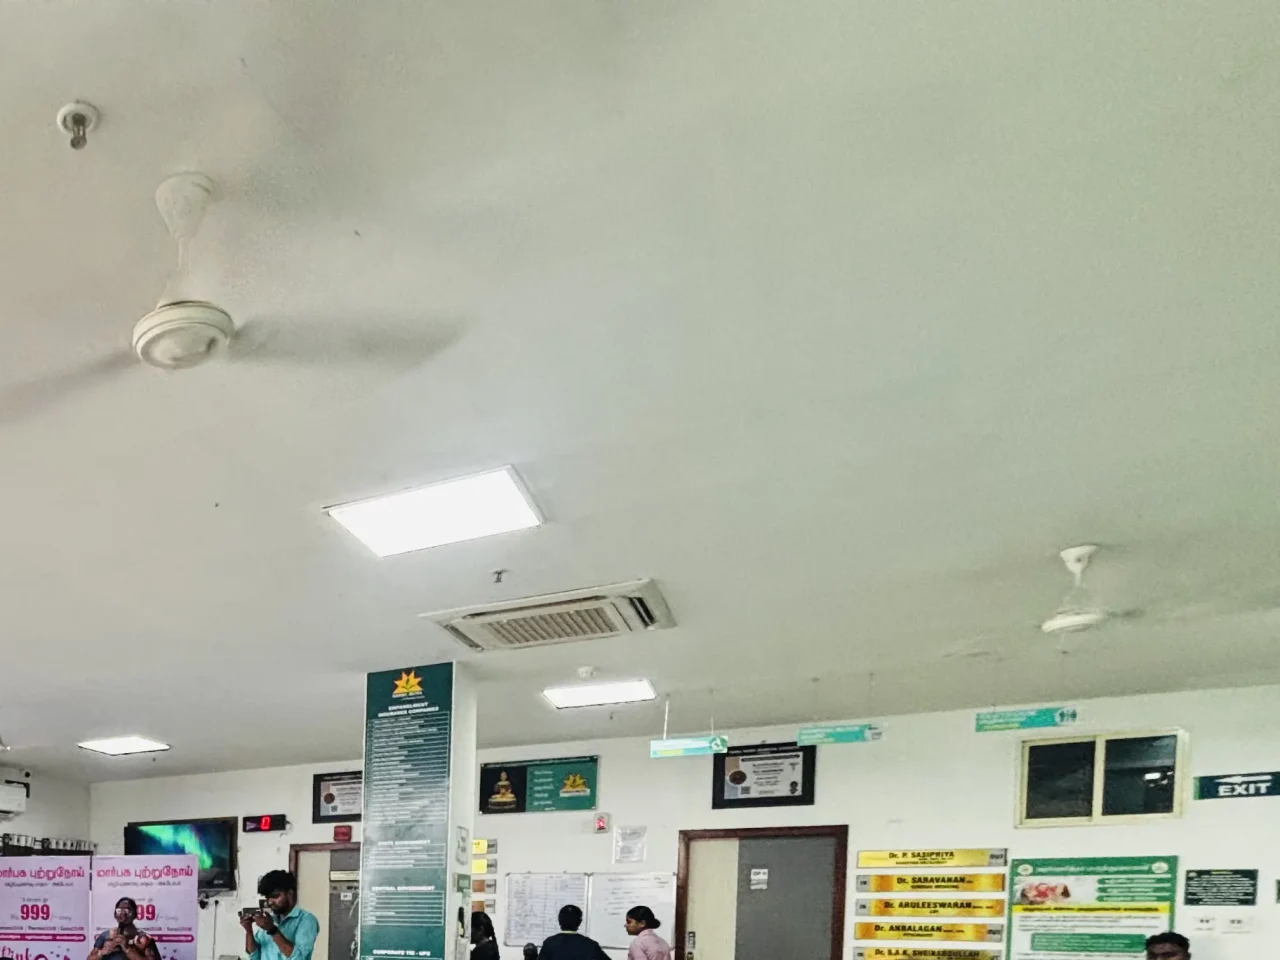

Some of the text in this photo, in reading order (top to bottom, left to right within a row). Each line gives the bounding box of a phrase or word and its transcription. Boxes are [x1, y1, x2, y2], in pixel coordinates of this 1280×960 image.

[1218, 782, 1272, 796] EXIT
[30, 866, 85, 880] புற்றுநோய்
[96, 865, 193, 880] மார்பக புற்றுநோய்
